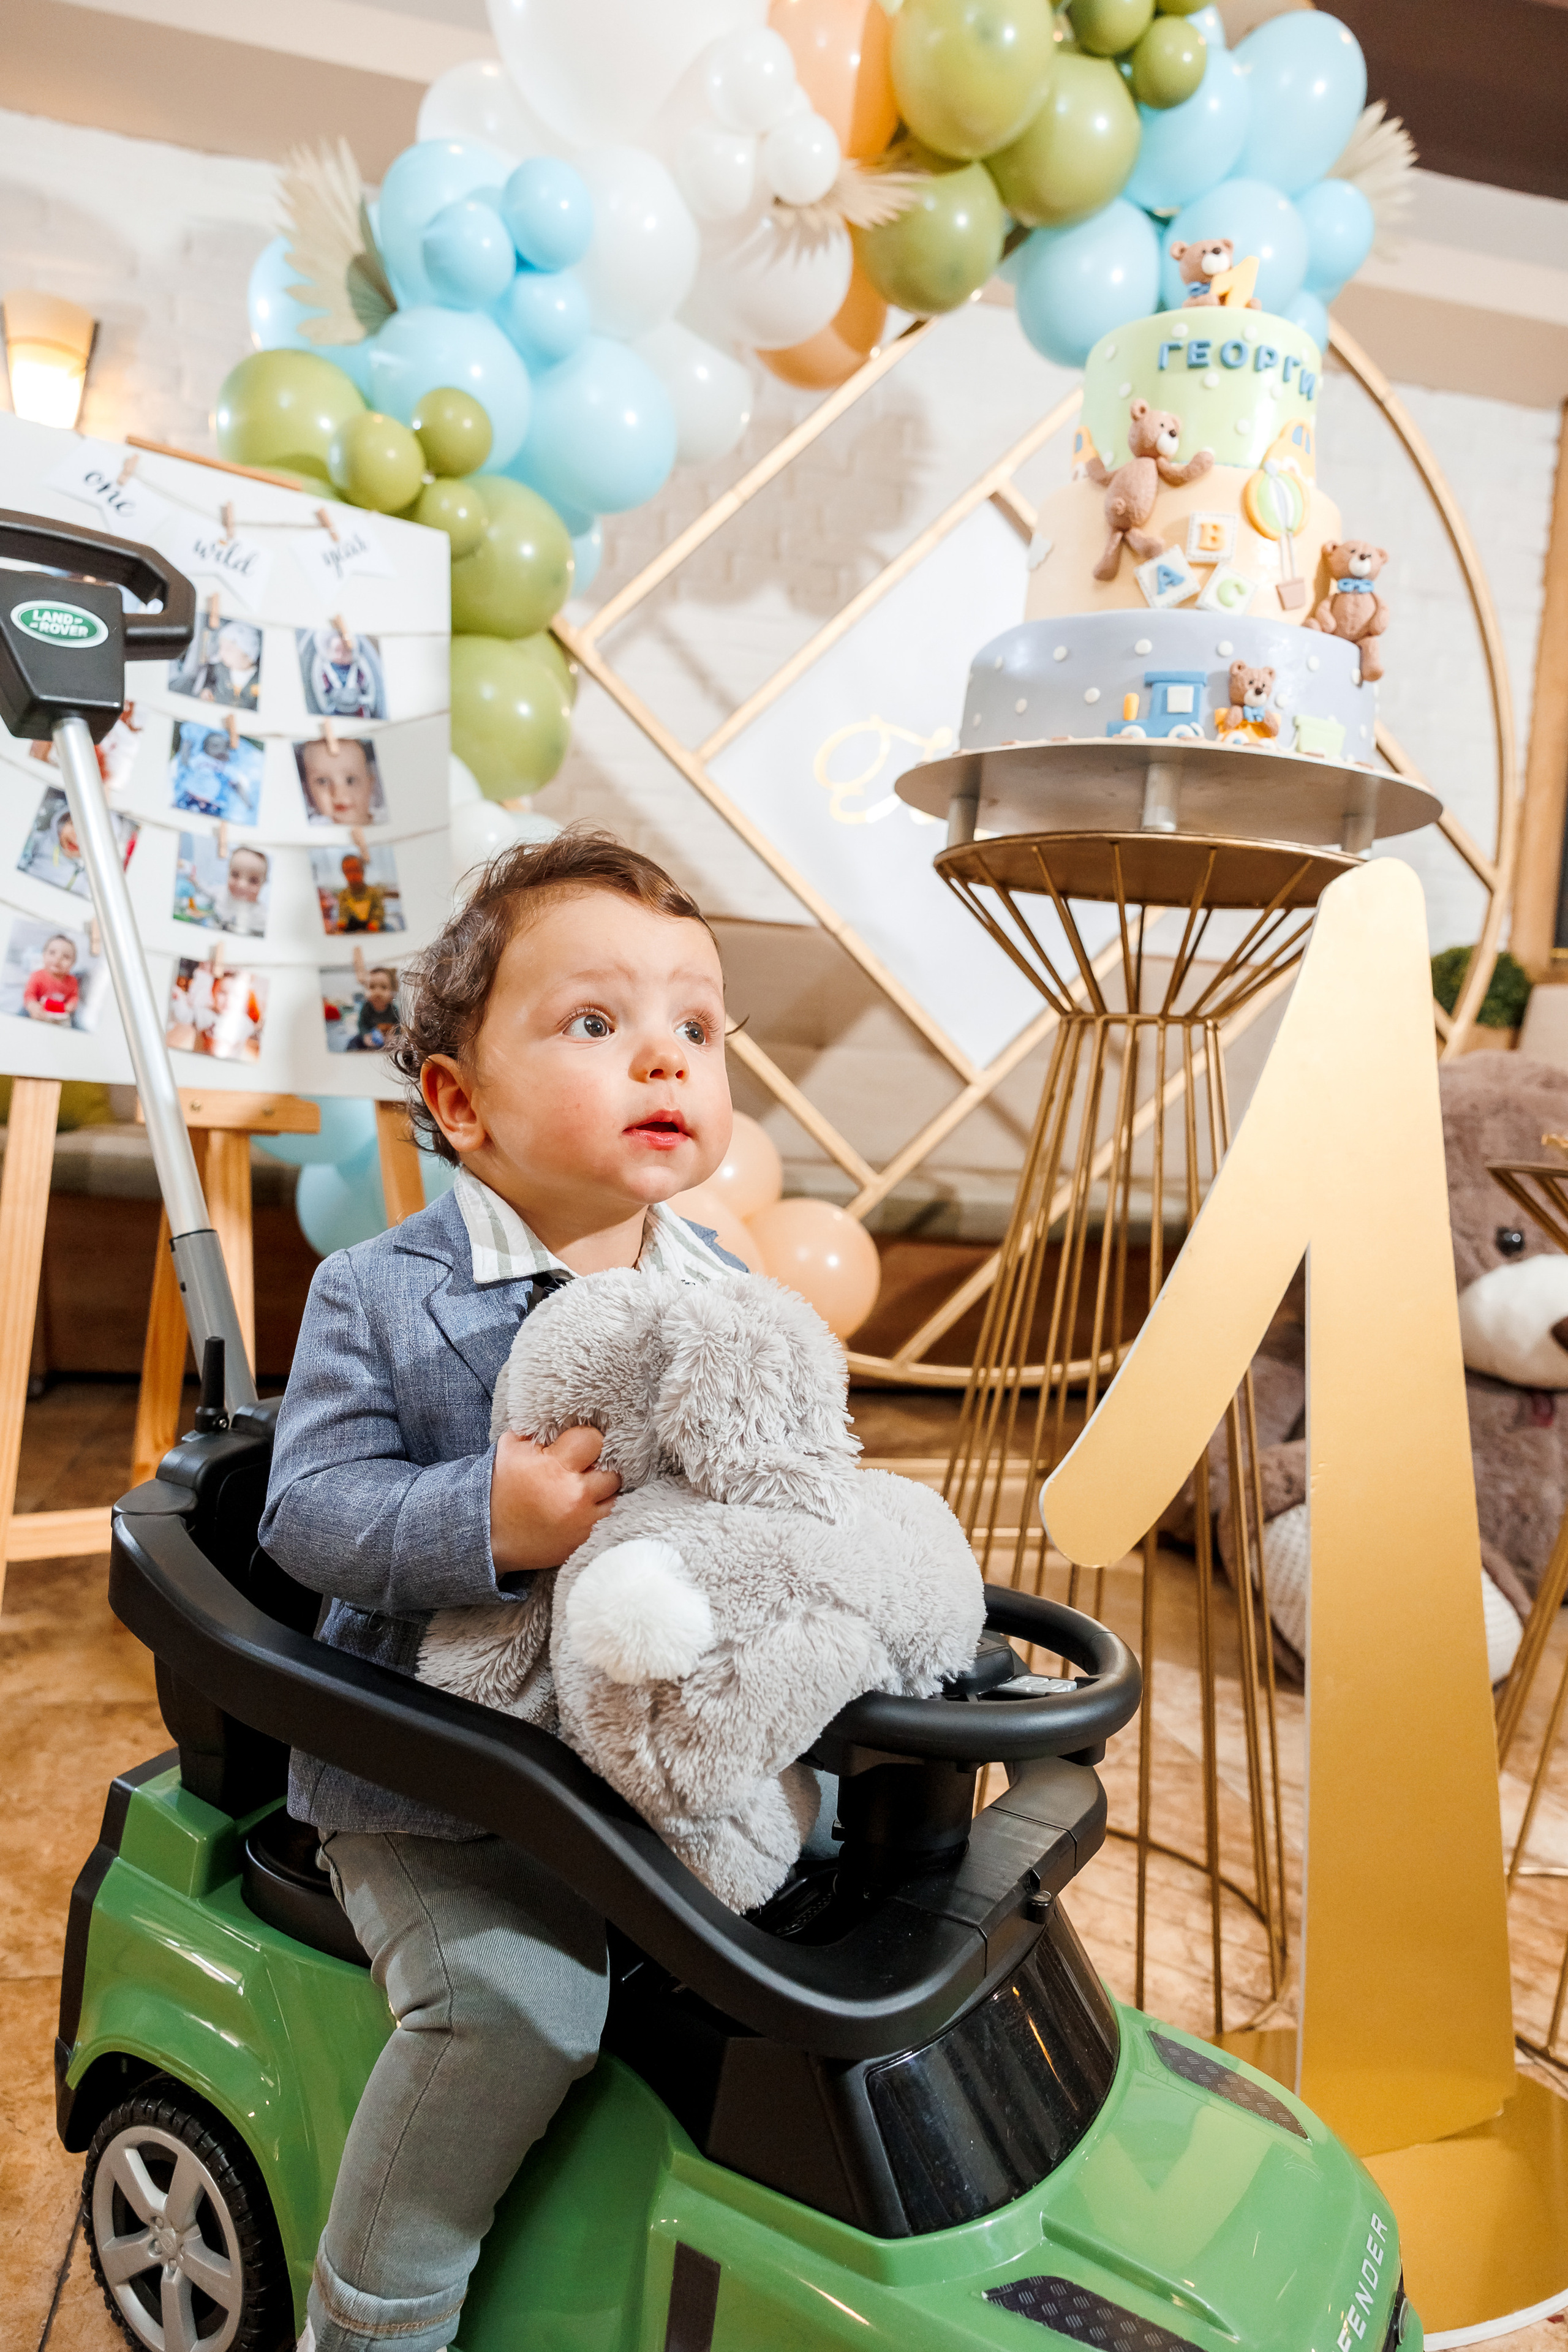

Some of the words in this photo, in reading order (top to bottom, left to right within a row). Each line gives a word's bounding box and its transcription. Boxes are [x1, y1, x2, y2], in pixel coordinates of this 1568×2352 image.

[1158, 339, 1316, 402] ГЕОРГИ
[85, 471, 136, 518] one
[192, 539, 257, 577] wild
[1198, 522, 1226, 551] B
[1156, 564, 1185, 595] A
[1216, 578, 1246, 608] C
